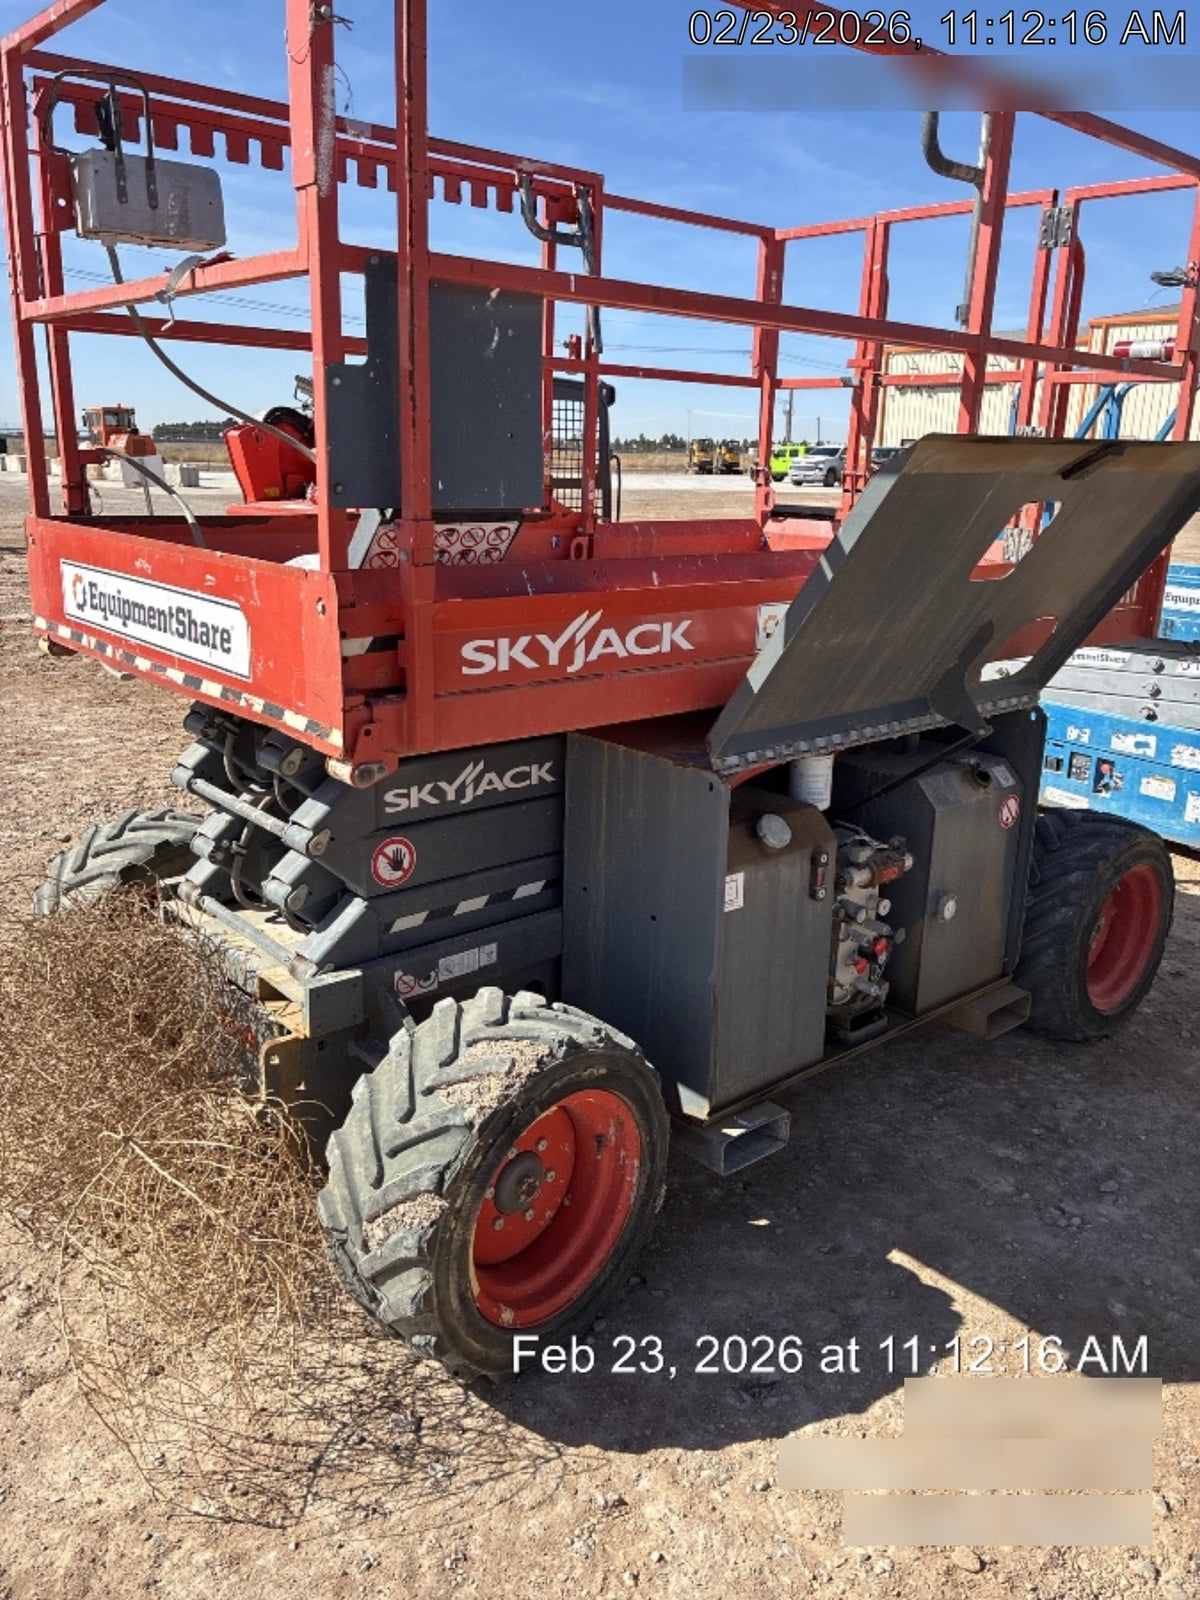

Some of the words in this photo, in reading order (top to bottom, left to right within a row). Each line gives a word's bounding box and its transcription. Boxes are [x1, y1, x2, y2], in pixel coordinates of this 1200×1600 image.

[88, 580, 233, 655] EquipmentShare
[461, 609, 694, 675] SKYJACK
[384, 759, 556, 813] SKYJACK
